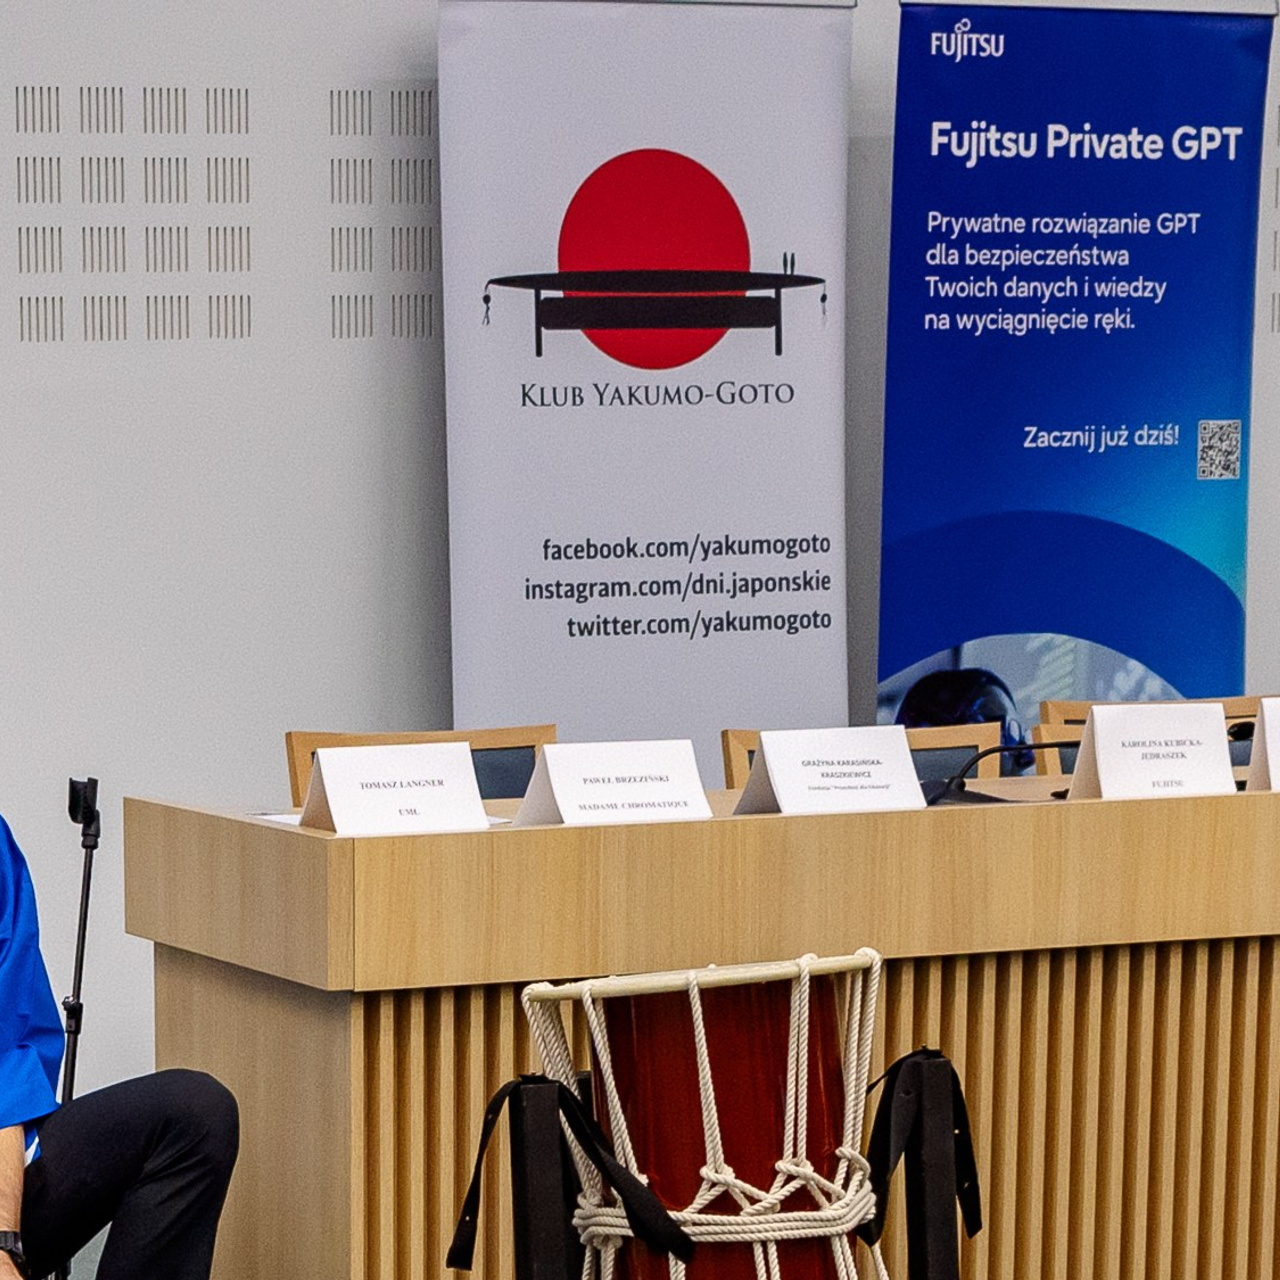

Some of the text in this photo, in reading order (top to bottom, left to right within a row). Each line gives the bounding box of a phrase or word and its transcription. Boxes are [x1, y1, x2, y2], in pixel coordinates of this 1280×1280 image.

[931, 18, 1005, 63] FUJITSU
[931, 120, 1244, 168] Fujitsu Private GPT
[927, 211, 1201, 239] Prywatne rozwiązanie GPT
[925, 243, 1130, 271] dla bezpieczeństwa
[924, 275, 1167, 304] Twoich danych i wiedzy
[924, 307, 1136, 336] na wyciągnięcie ręki.
[520, 383, 585, 407] KLUB
[1023, 423, 1180, 453] Zacznij już dziś!
[542, 533, 831, 564] facebook.com/yakumogoto
[525, 569, 832, 603] instagram.com/dni.japonskie
[567, 609, 833, 641] twitter.com/yakumogoto
[1121, 740, 1163, 748] KAROLINA
[360, 779, 445, 790] TOMASZ LANGNER
[578, 801, 689, 811] MADAME CHROMATIQUE
